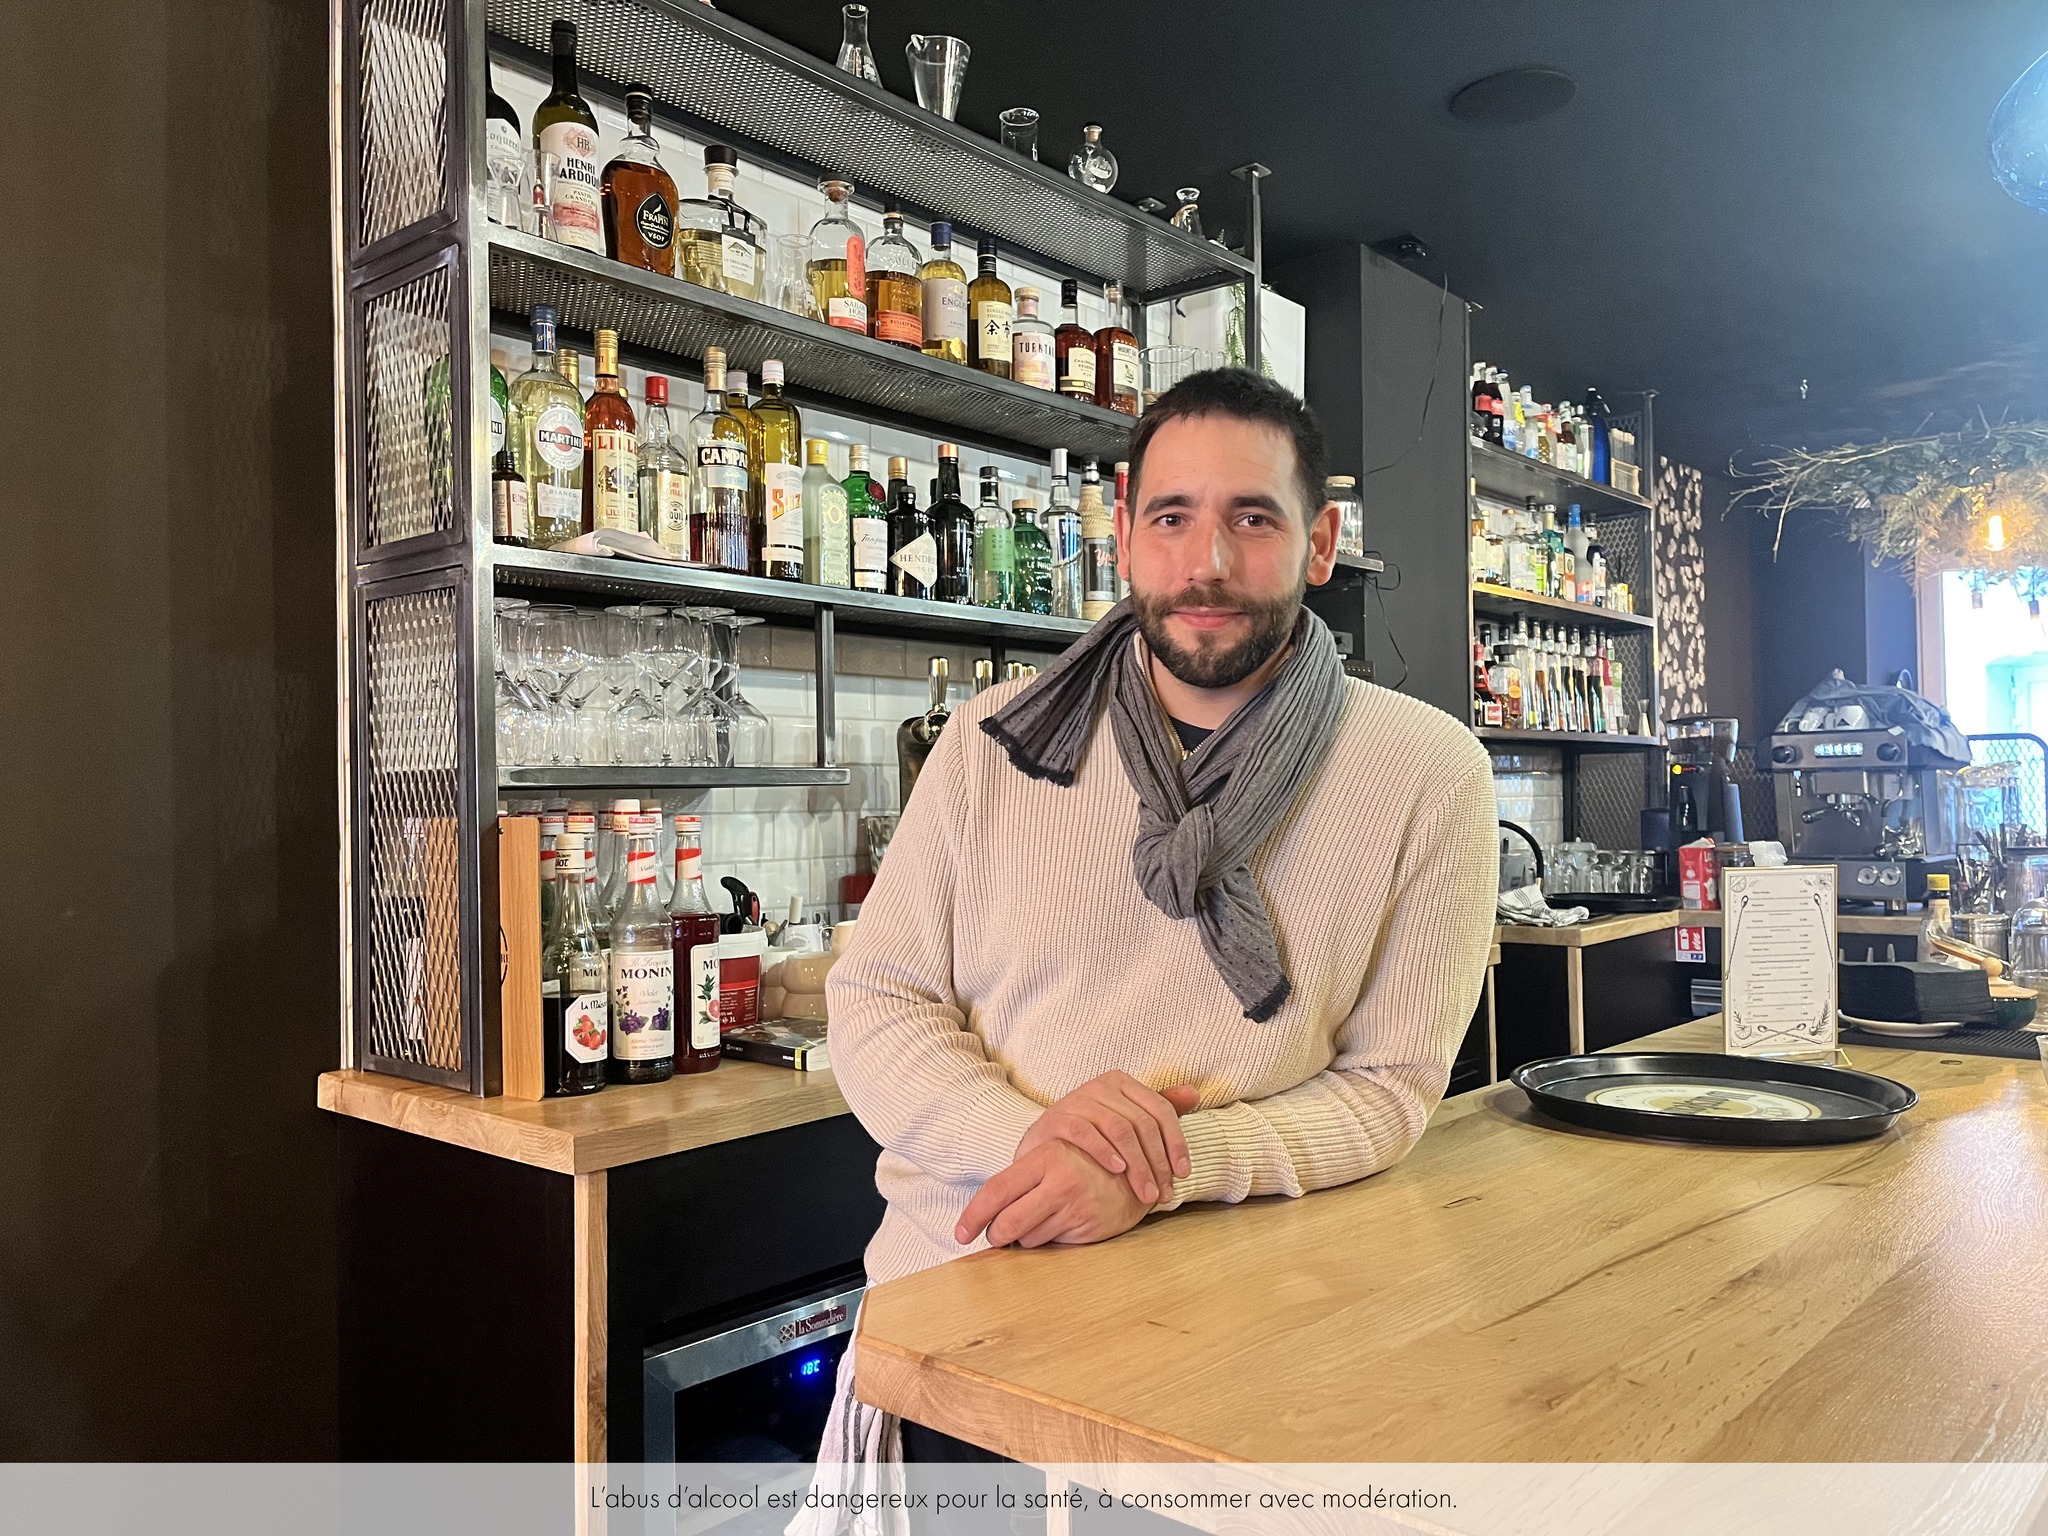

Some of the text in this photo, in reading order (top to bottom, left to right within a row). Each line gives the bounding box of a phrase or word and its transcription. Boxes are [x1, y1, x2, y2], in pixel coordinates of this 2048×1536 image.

[566, 156, 596, 176] HENRI
[558, 167, 600, 188] ARDOU
[540, 430, 582, 449] MARTINI
[701, 447, 747, 469] CAMPA
[620, 966, 672, 980] MONIN
